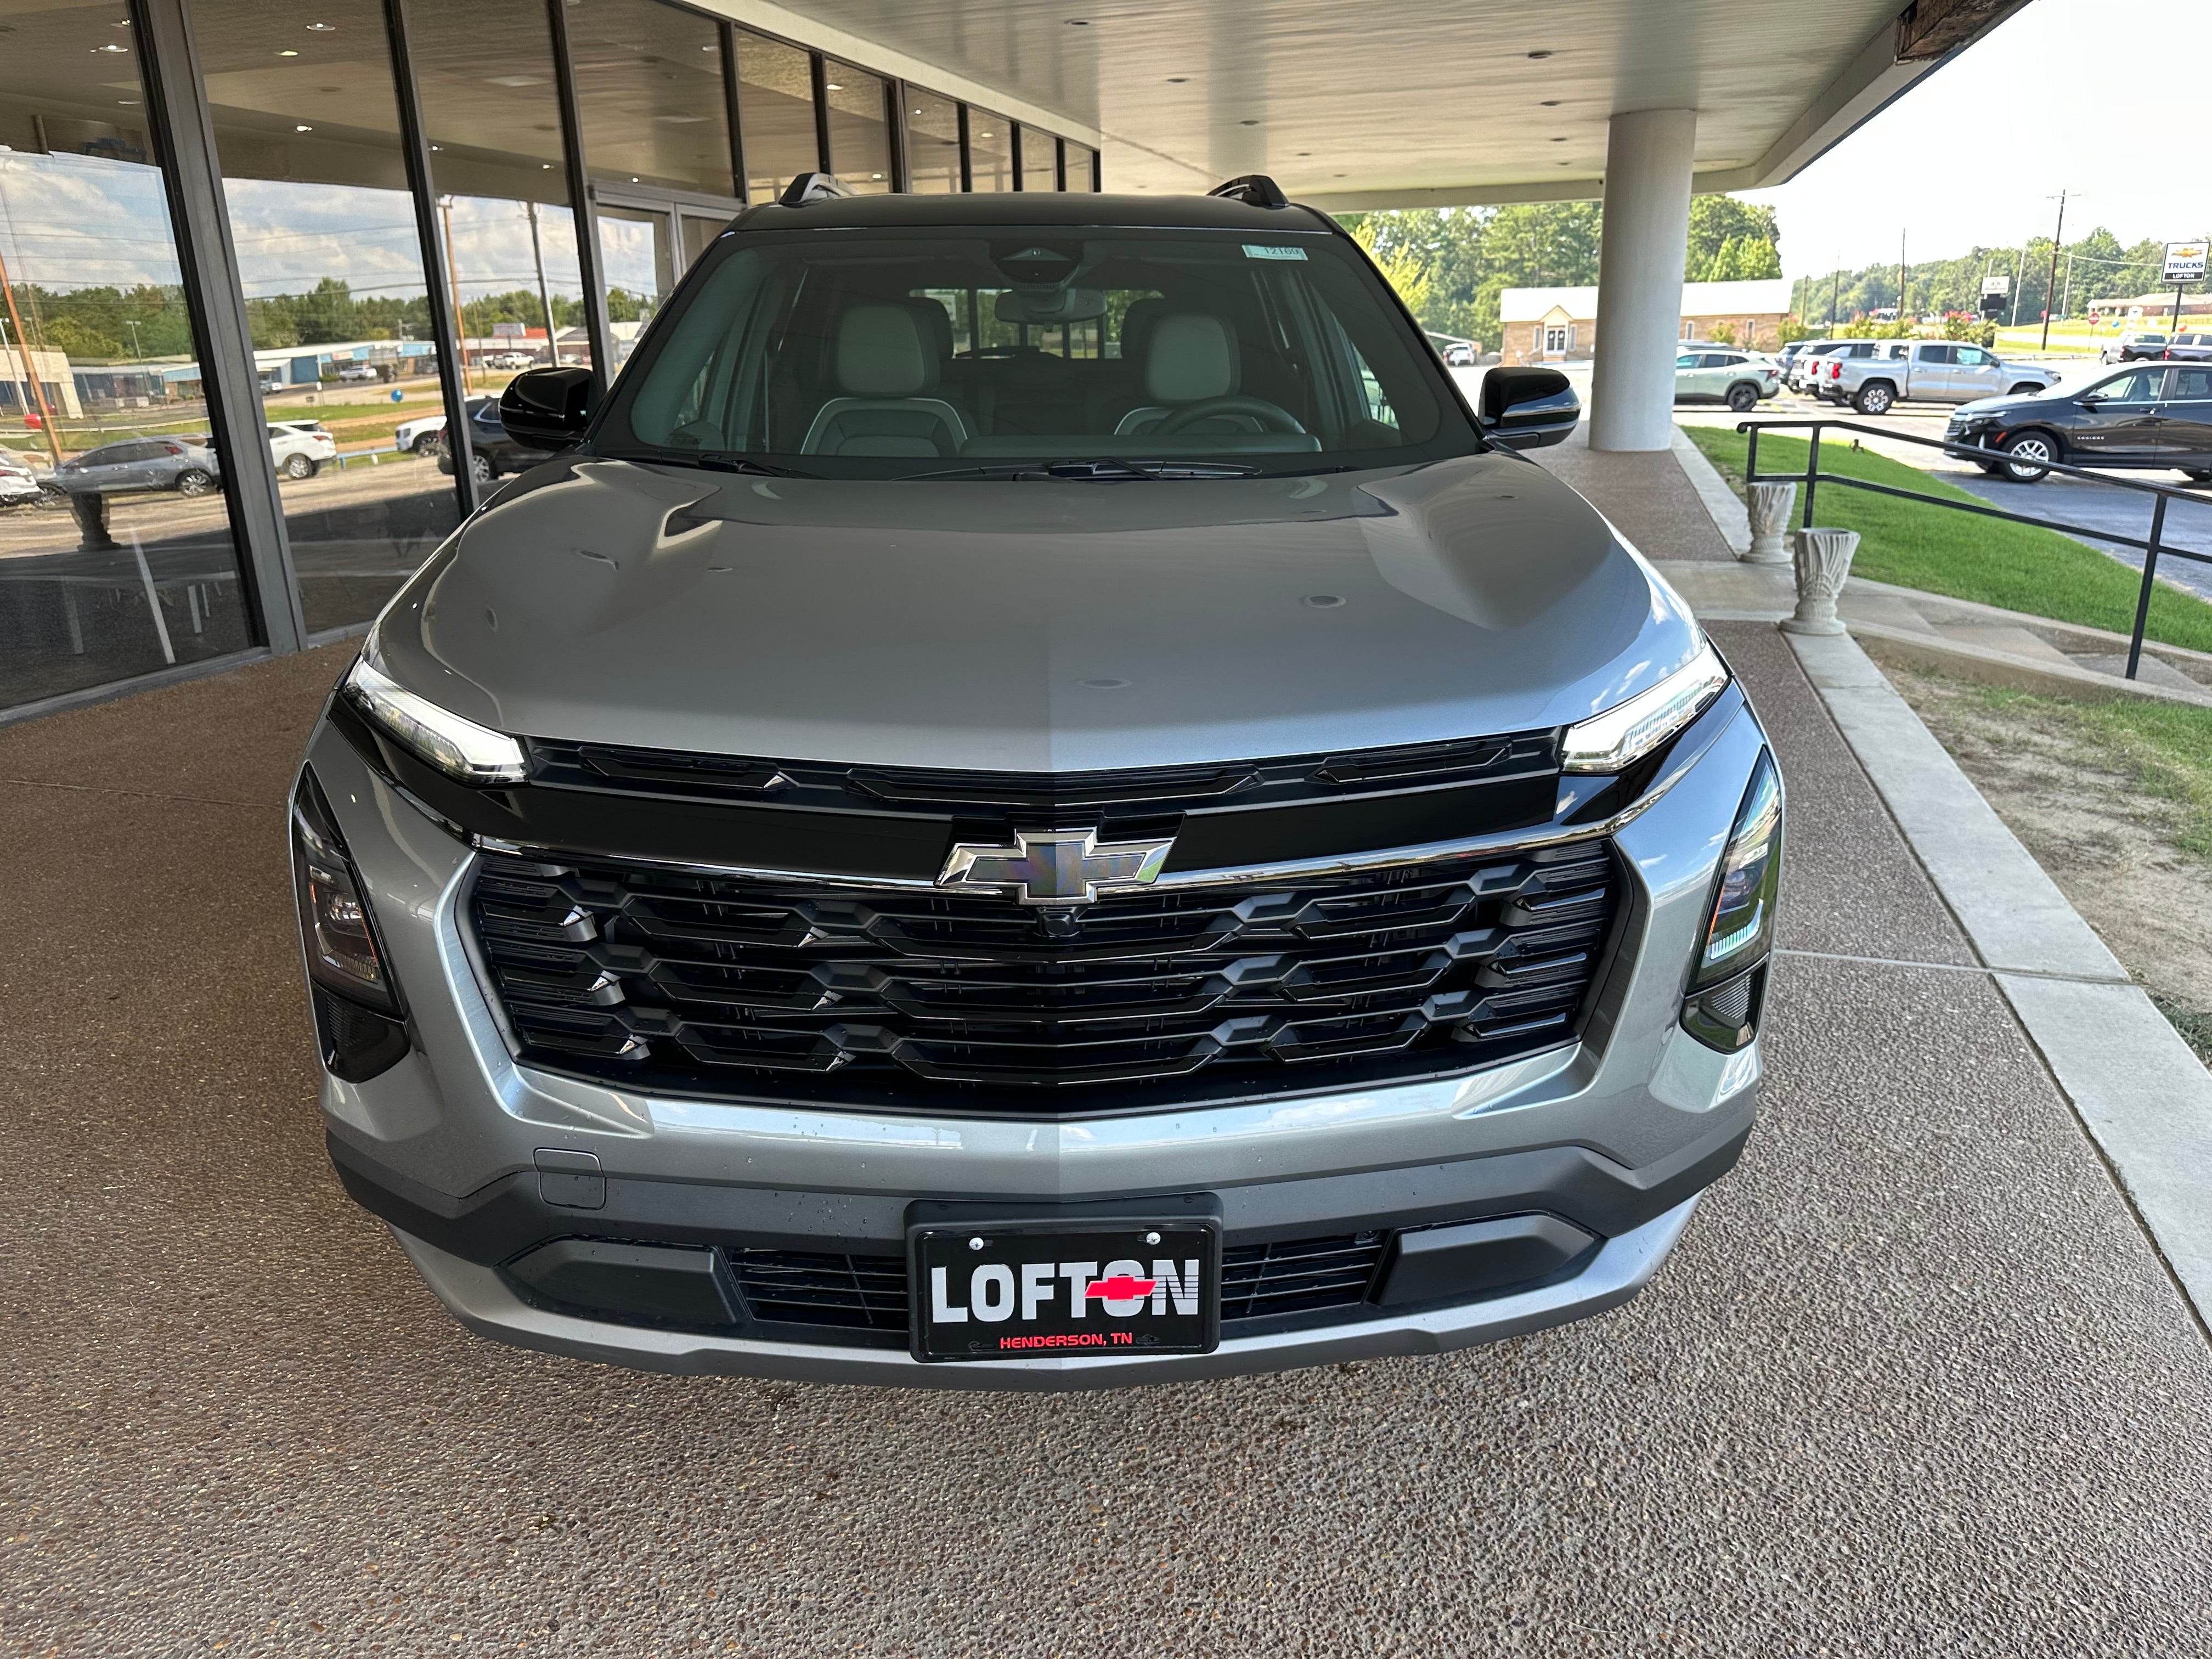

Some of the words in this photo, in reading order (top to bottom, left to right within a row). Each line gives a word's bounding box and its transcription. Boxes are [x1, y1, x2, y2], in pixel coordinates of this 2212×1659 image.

[932, 1259, 1199, 1323] LOFTON
[1000, 1334, 1107, 1348] HENDERSON,
[1110, 1333, 1132, 1345] TN
